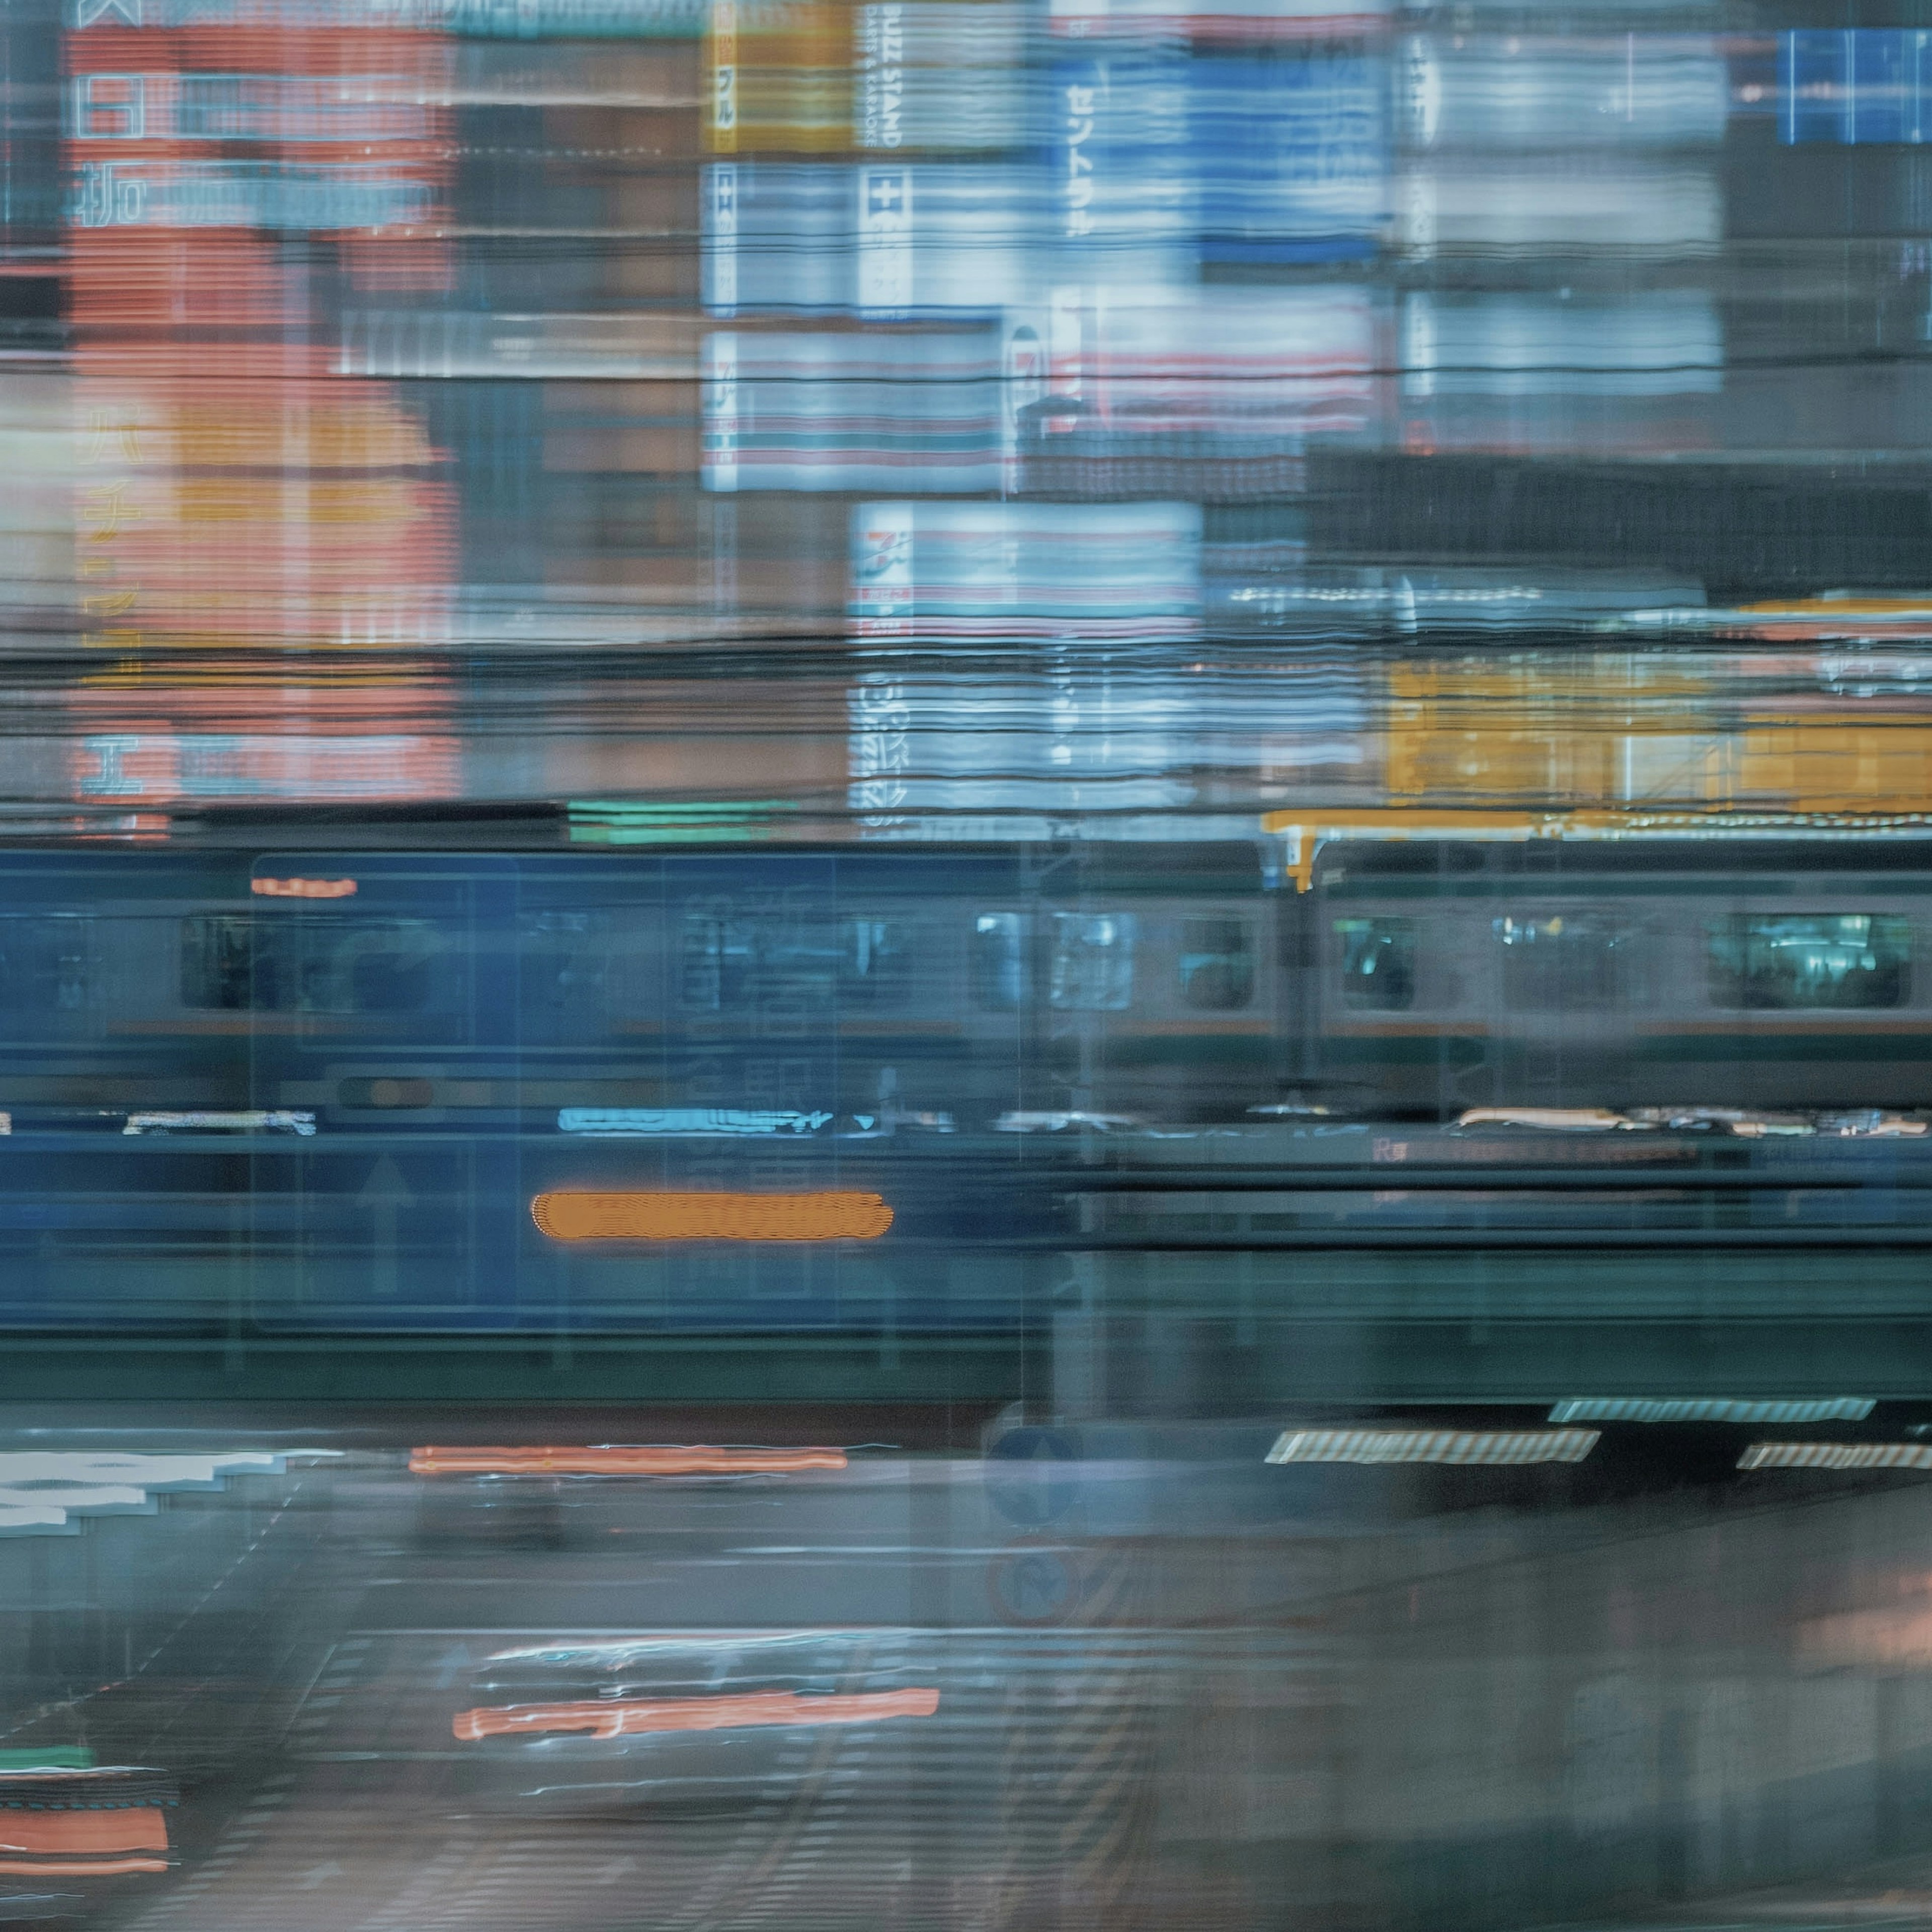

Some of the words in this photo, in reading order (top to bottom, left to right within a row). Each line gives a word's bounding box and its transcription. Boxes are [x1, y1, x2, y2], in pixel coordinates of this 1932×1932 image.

[865, 6, 878, 52] DARTS
[882, 5, 903, 64] BUZZ
[865, 59, 877, 69] &
[865, 73, 878, 147] KARAOKE
[882, 68, 903, 148] STAND
[1066, 84, 1094, 236] セントラル
